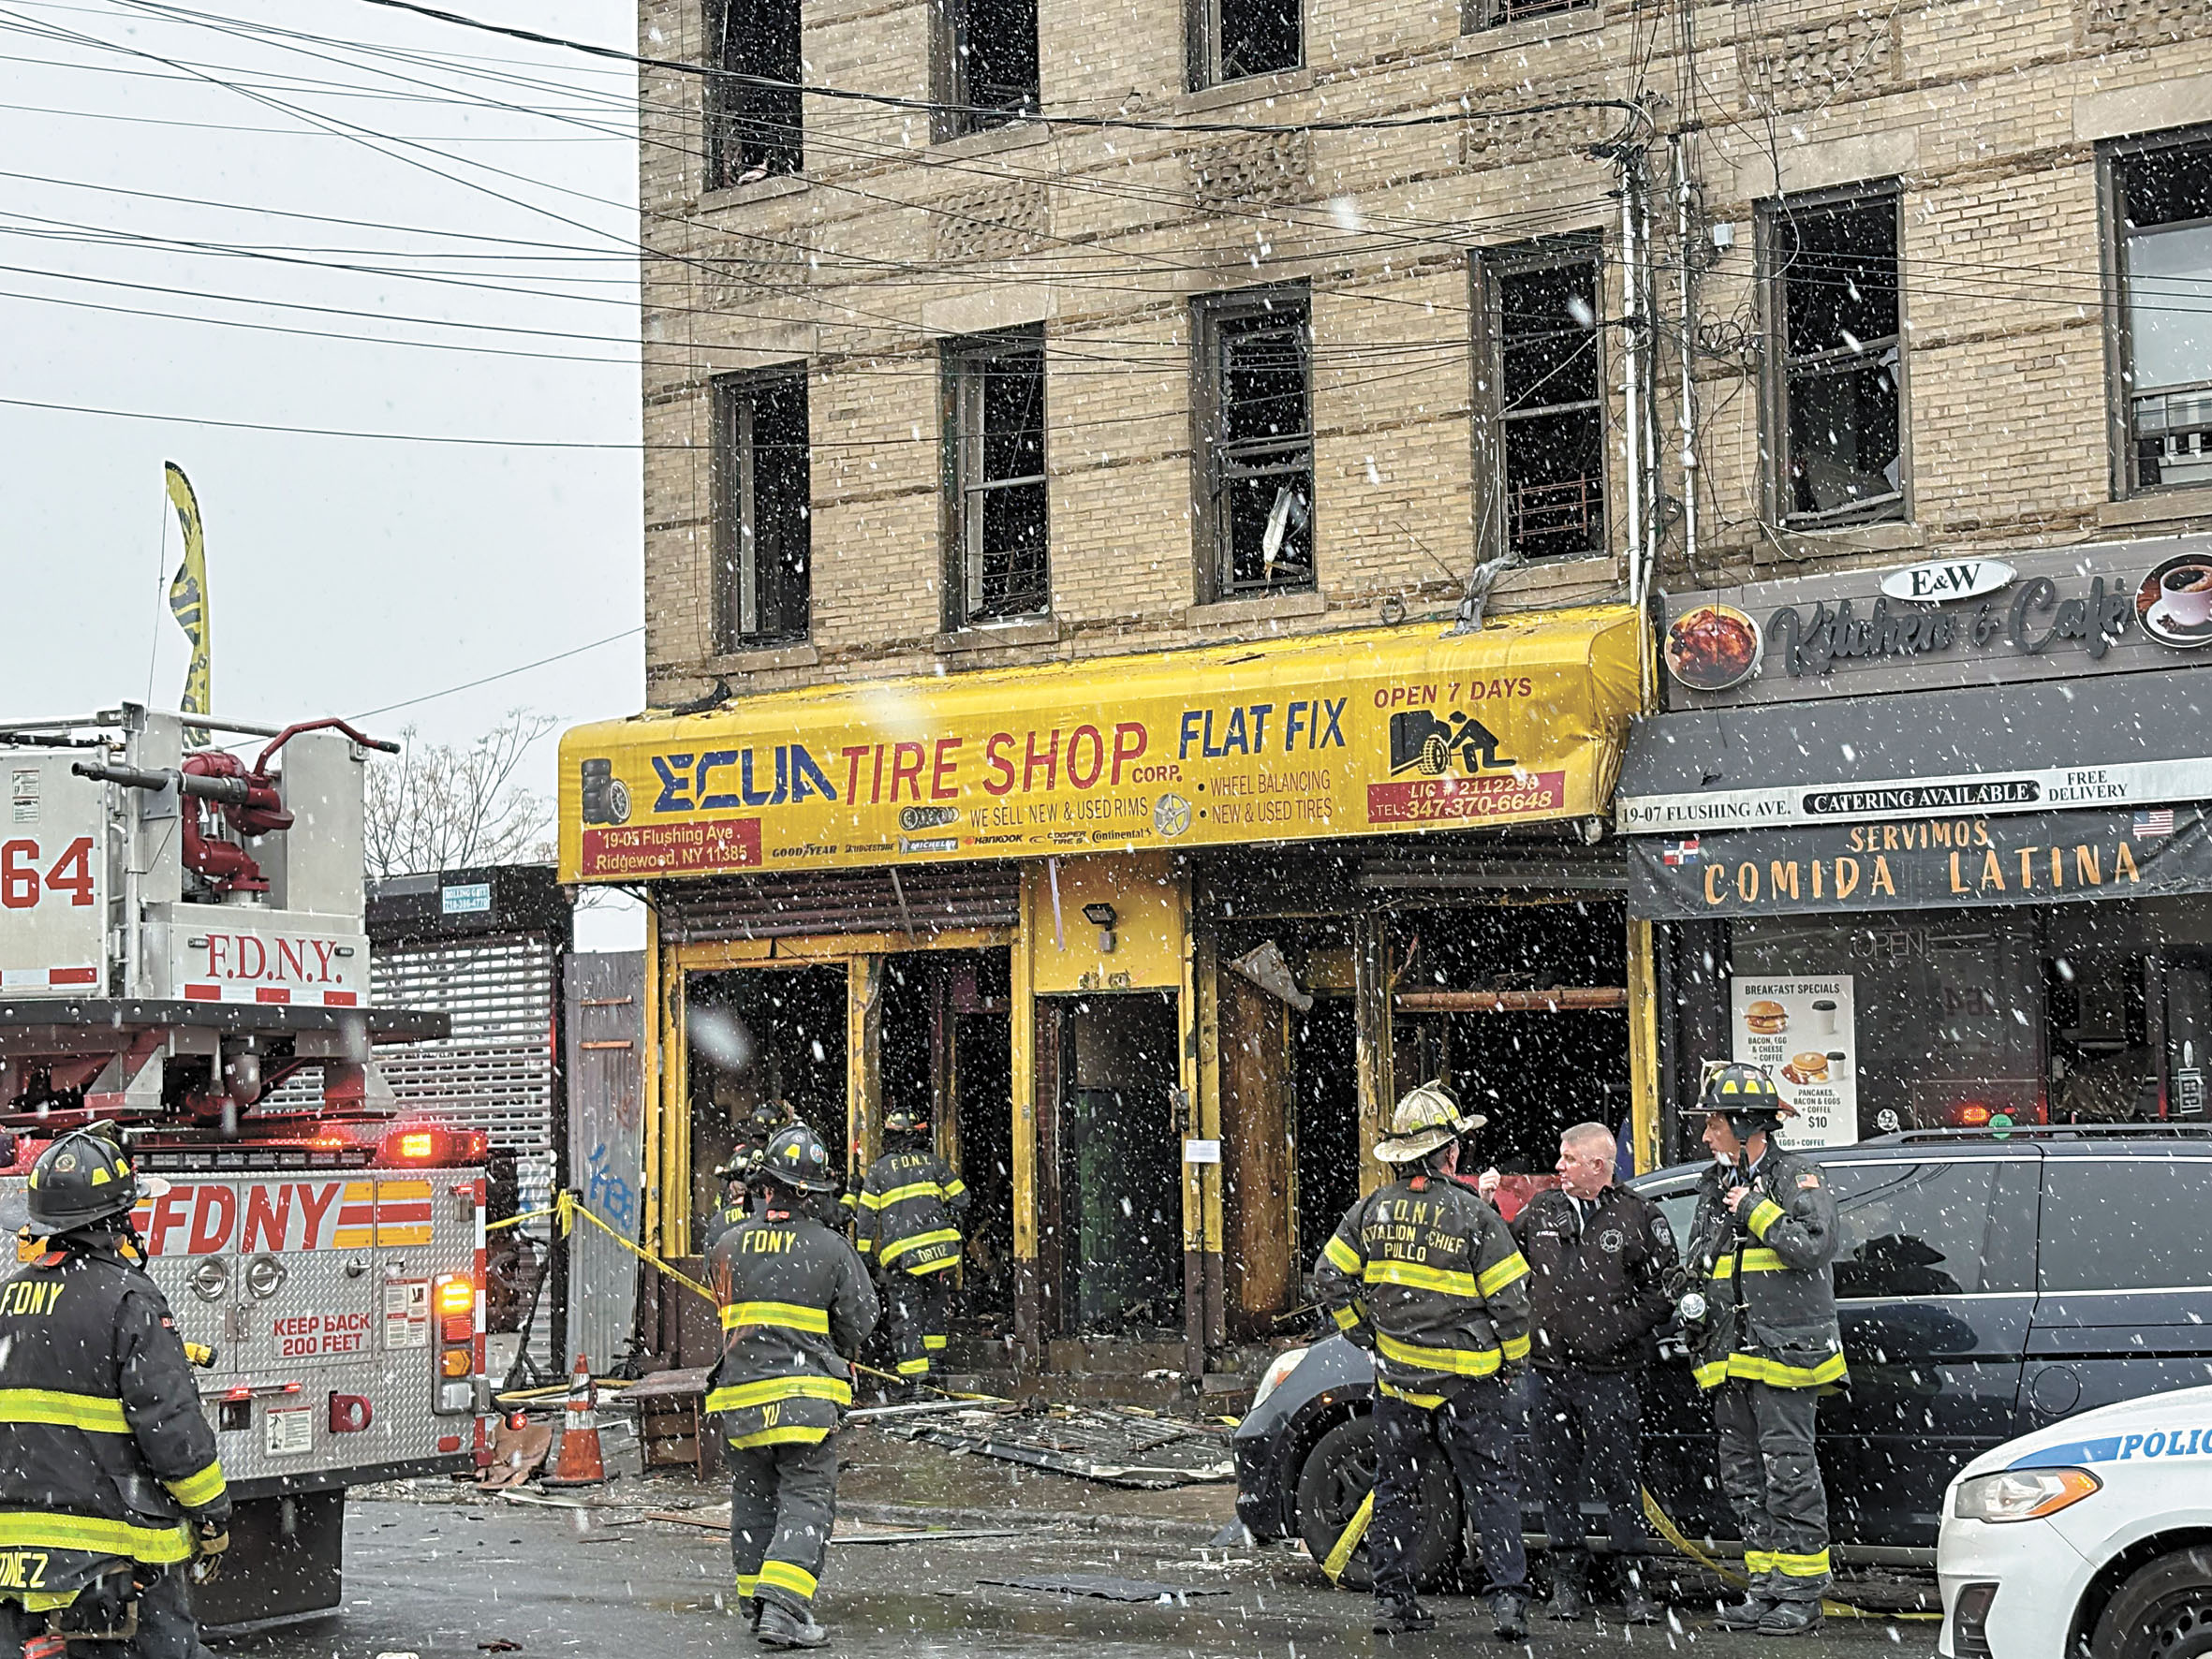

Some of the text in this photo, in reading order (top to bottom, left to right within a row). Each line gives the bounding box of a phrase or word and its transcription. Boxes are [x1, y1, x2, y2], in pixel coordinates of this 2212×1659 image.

[1910, 564, 1982, 596] E&W
[1766, 597, 1956, 677] Kitchen
[1374, 678, 1532, 709] OPEN 7 DAYS
[1178, 697, 1349, 760] FLAT FIX
[652, 722, 1148, 814] ECUA TIRE SHOP
[1131, 765, 1183, 784] CORP.
[2067, 770, 2108, 785] FREE
[1209, 769, 1331, 797] WHEEL BALANCING
[1410, 783, 1435, 799] LIC
[2048, 783, 2128, 801] DELIVERY
[1212, 797, 1333, 824] NEW & USED TIRES
[1406, 790, 1553, 819] 347-370-6648
[1623, 800, 1792, 823] 19-07 FLUSHING AVE.
[1813, 784, 2029, 814] CATERING AVAILABLE
[970, 797, 1148, 829] WE SELL NEW & USED RIMS
[642, 828, 703, 845] Flushing
[705, 825, 733, 840] Ave
[1092, 830, 1143, 843] Continental
[1850, 820, 1989, 853] SERVIMOS
[597, 844, 747, 873] Ridgewood, NY 11385
[773, 844, 837, 858] GOODYEAR
[1704, 842, 2140, 905] COMIDA LATINA
[1852, 930, 1924, 958] OPEN
[205, 933, 343, 984] F.D.N.Y.
[1745, 983, 1840, 995] BREAKFAST SPECIALS
[1759, 1045, 1783, 1053] CHEESE
[1759, 1053, 1783, 1062] COFFEE
[1793, 1097, 1817, 1106] BACON
[1808, 1116, 1827, 1129] $10
[1801, 1138, 1825, 1147] COFFEE
[148, 1182, 342, 1256] FDNY
[742, 1229, 796, 1254] FDNY
[917, 1243, 948, 1263] ORTIZ
[1384, 1242, 1426, 1262] PULLO
[1428, 1230, 1466, 1255] CHIEF
[0, 1281, 66, 1316] FDNY
[273, 1312, 371, 1337] KEEP BACK
[283, 1332, 363, 1357] 200 FEET
[762, 1402, 780, 1428] YU
